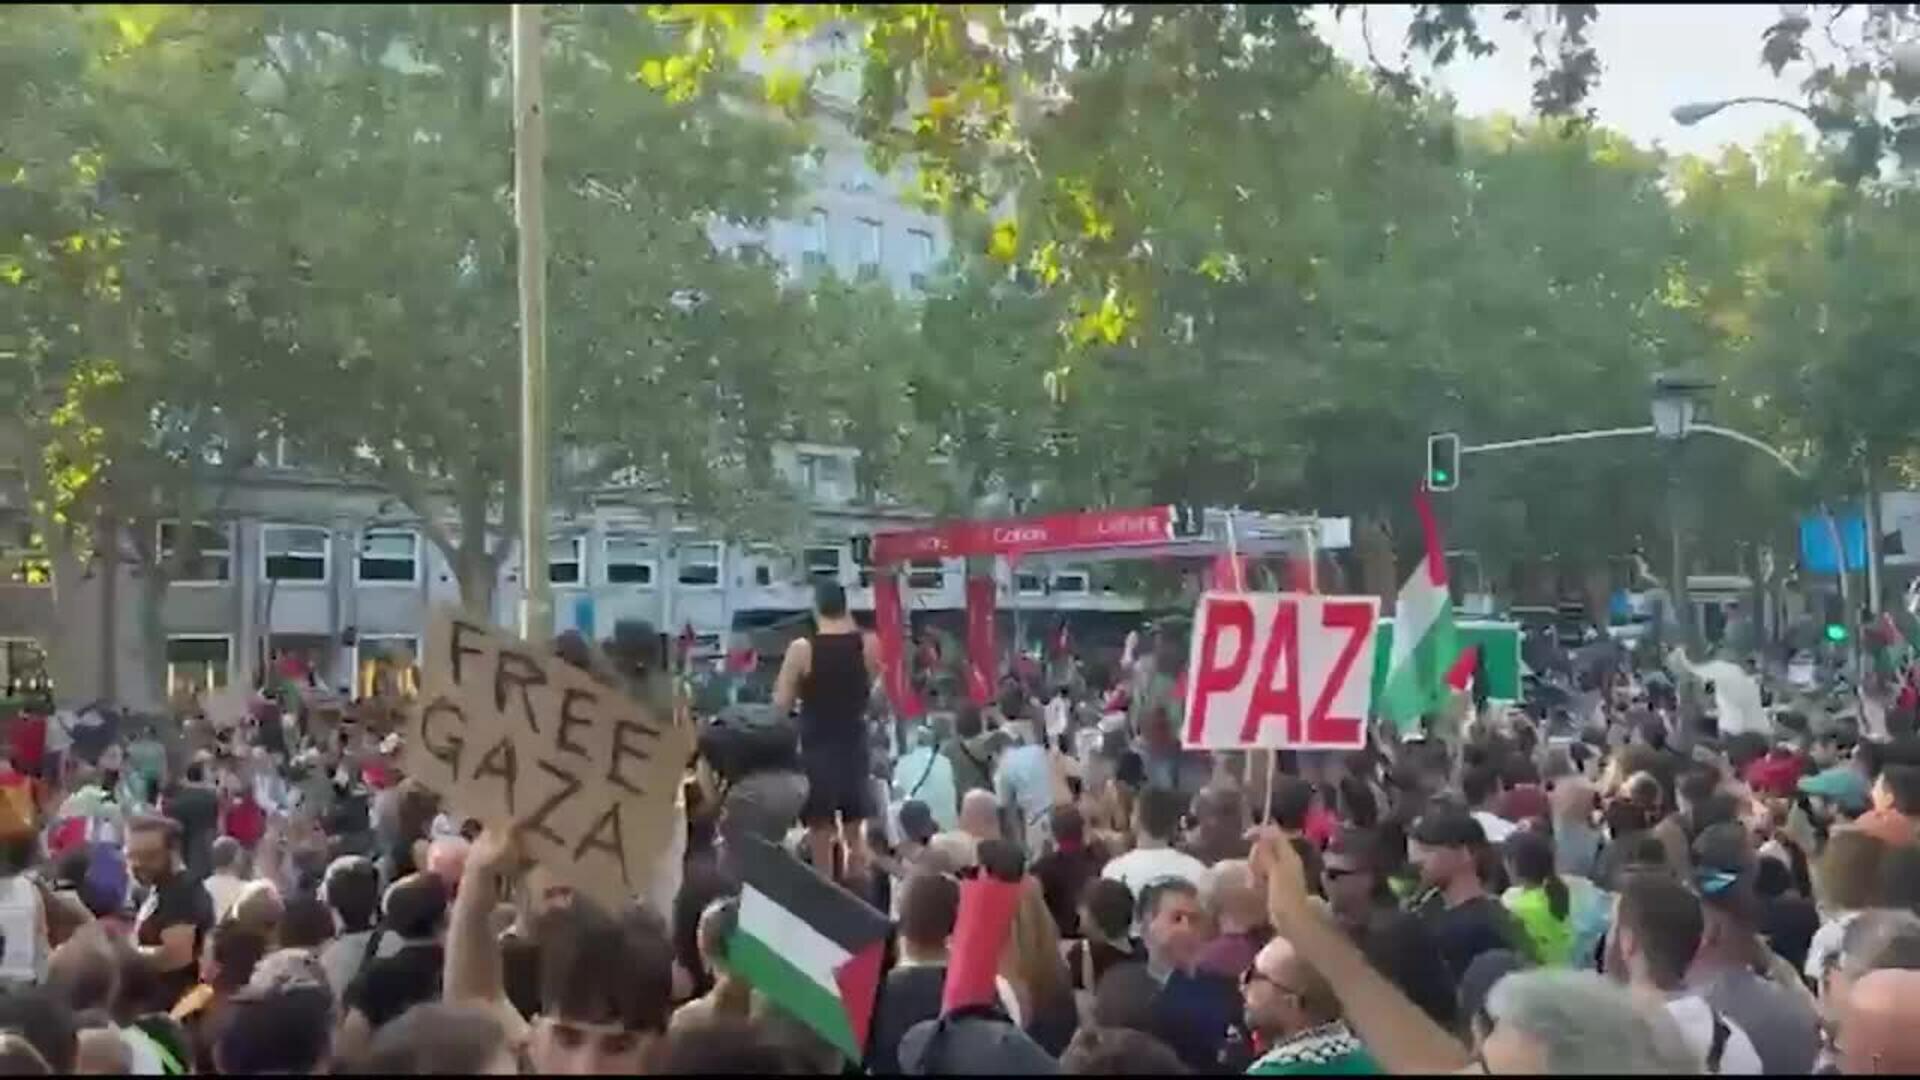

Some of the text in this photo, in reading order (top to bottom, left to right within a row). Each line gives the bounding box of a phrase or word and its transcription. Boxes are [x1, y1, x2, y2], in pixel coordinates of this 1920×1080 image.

[451, 620, 661, 796] FREE
[1188, 600, 1374, 742] PAZ
[421, 696, 632, 888] GAZA
